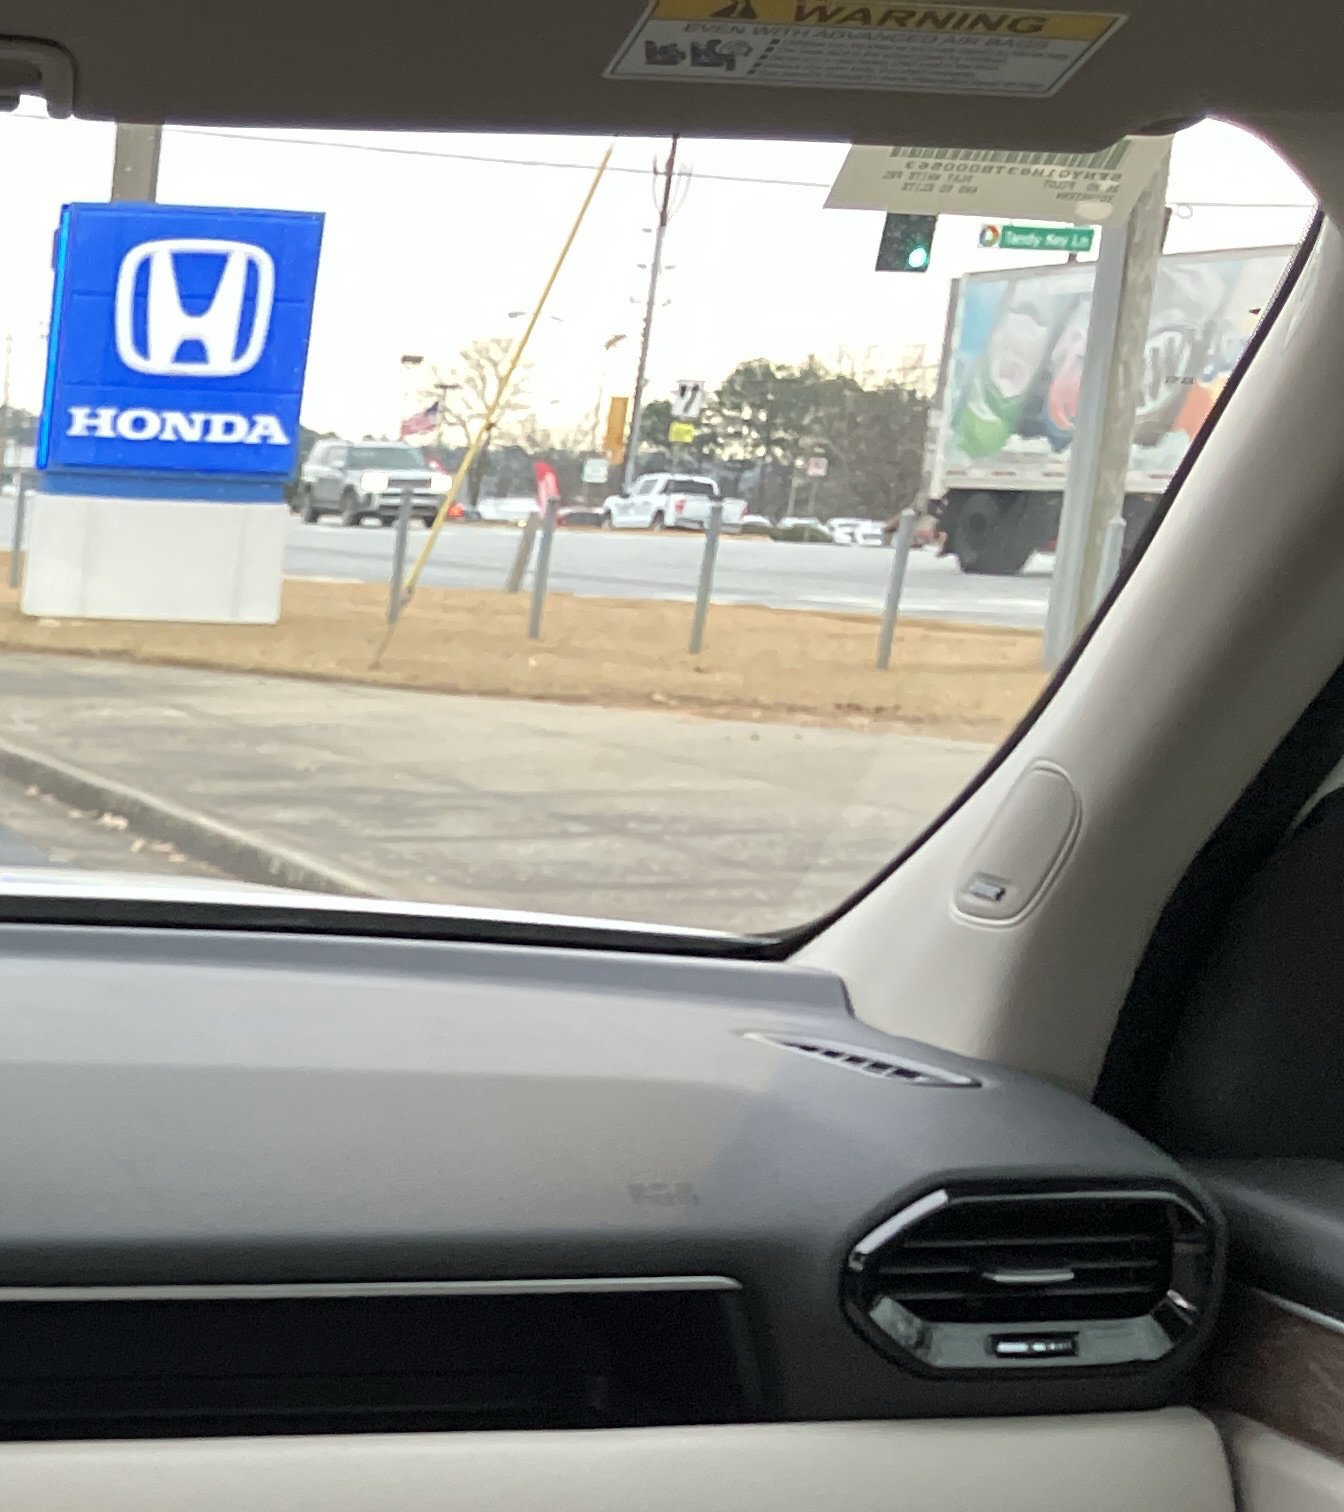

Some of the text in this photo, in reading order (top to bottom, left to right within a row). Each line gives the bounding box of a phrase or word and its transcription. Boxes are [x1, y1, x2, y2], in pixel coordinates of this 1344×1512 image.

[793, 2, 1050, 33] WARNING
[816, 28, 939, 44] ADVANCED
[65, 405, 291, 446] HONDA
